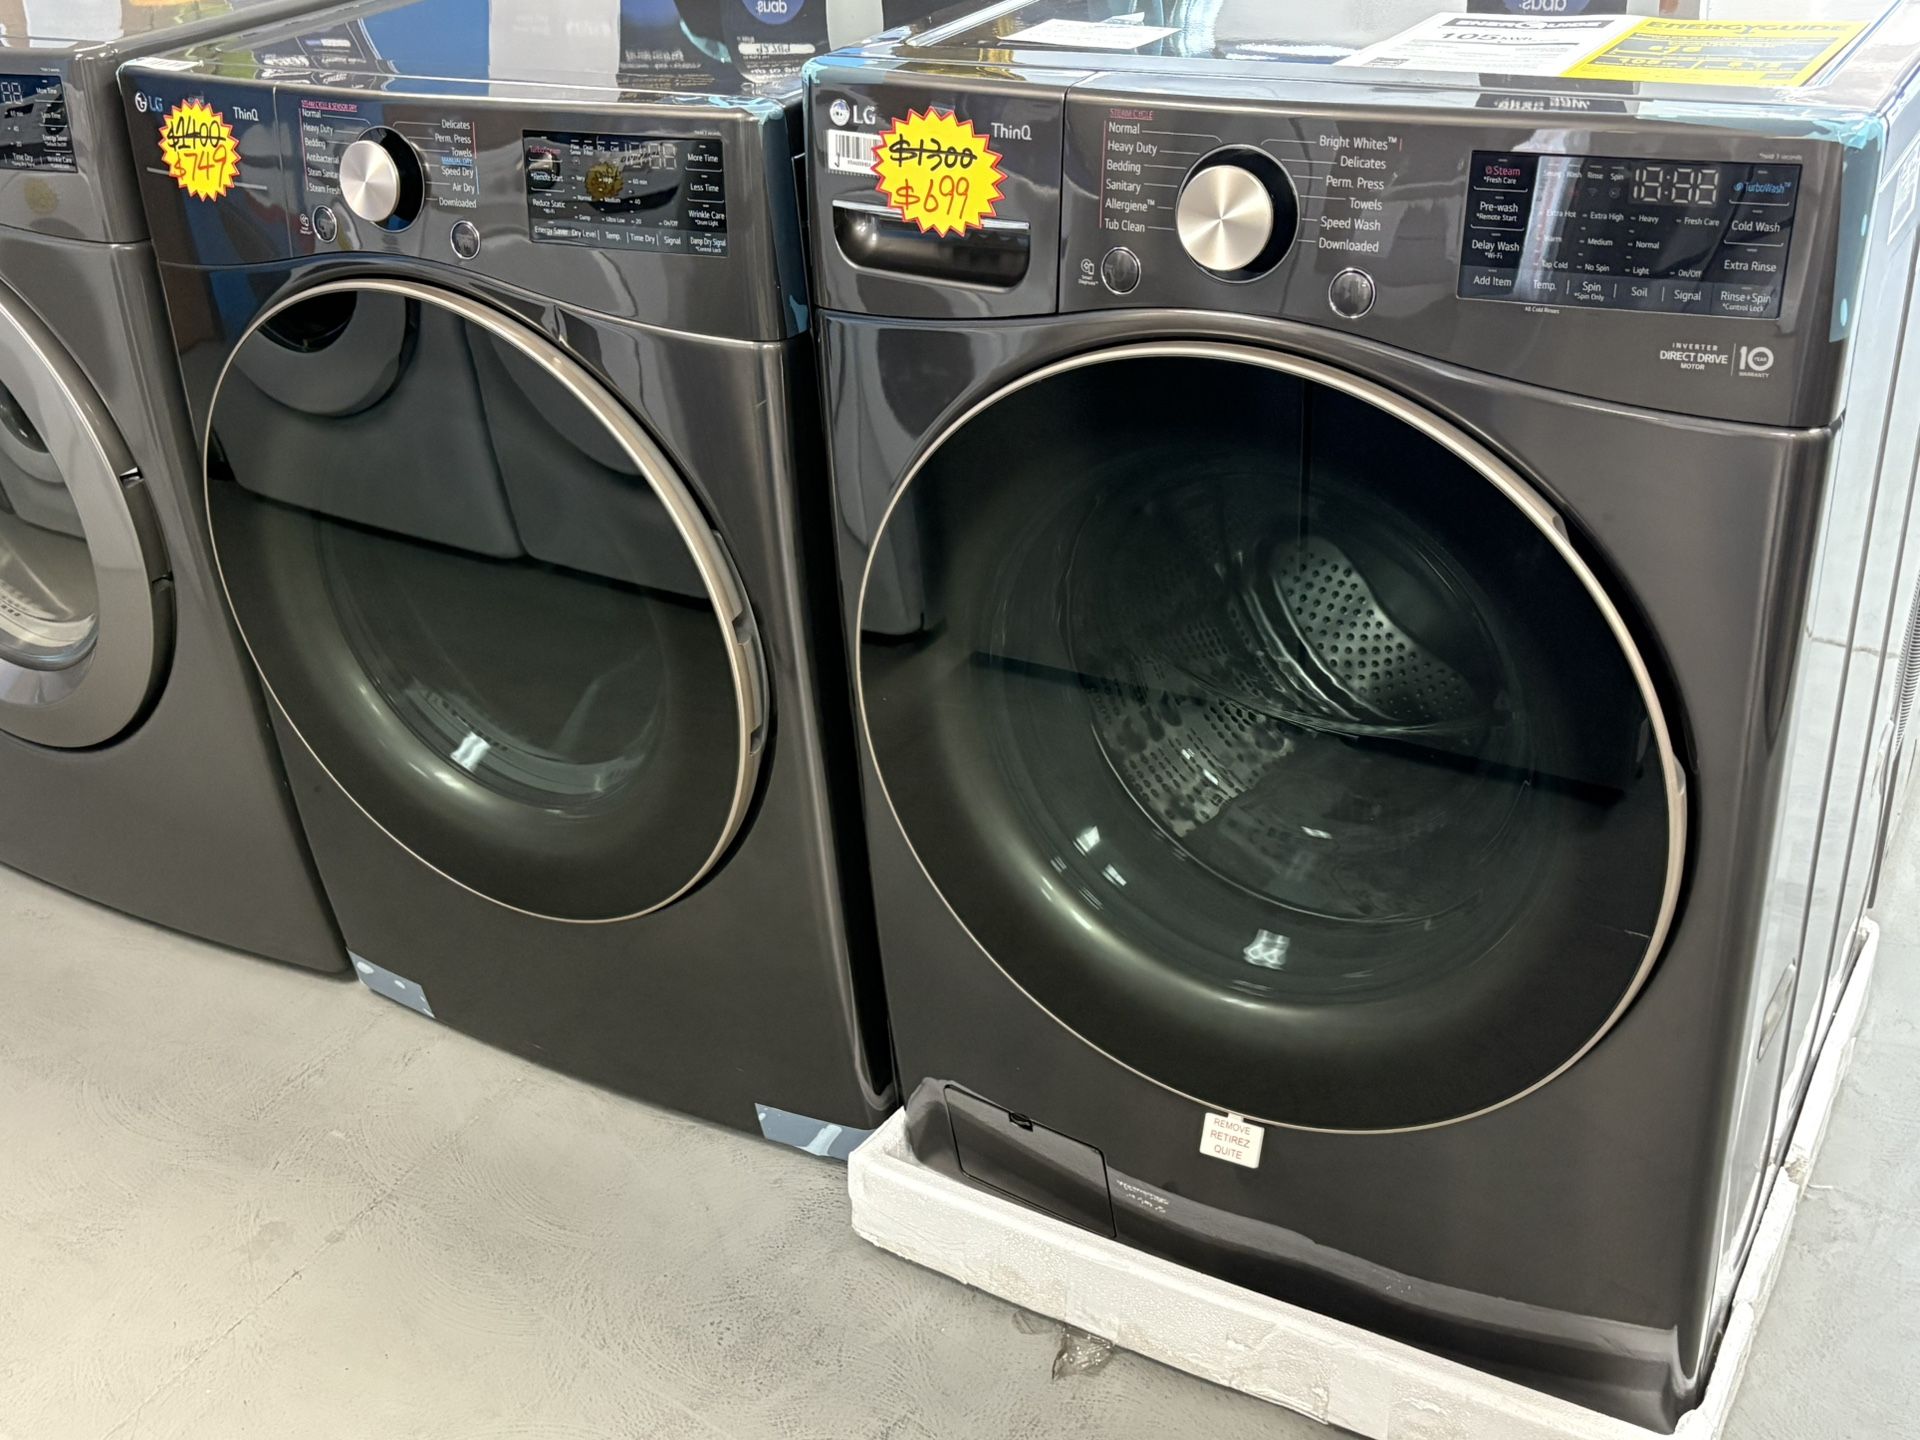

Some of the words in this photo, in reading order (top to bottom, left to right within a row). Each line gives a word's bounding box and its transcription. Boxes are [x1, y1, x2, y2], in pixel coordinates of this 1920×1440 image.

[148, 95, 163, 112] LG
[232, 106, 259, 121] ThinQ
[302, 109, 321, 118] Normal
[853, 105, 876, 125] LG
[303, 123, 320, 134] Heavy
[320, 124, 334, 135] Duty
[441, 119, 470, 130] Delicates
[1108, 122, 1140, 134] Normal
[167, 115, 226, 151] $1400
[991, 123, 1032, 141] ThinQ
[304, 138, 326, 150] Bedding
[435, 133, 452, 144] Perm.
[454, 134, 471, 144] Press
[1319, 135, 1350, 150] Bright
[451, 147, 472, 157] Towels
[889, 134, 978, 171] $1300
[1107, 140, 1134, 155] Heavy
[1136, 142, 1158, 157] Duty
[688, 153, 702, 162] More
[704, 154, 719, 163] Time
[1340, 155, 1386, 170] Delicates
[174, 144, 227, 187] $749
[1106, 159, 1141, 175] Bedding
[1492, 165, 1521, 176] Steam
[441, 167, 460, 177] Speed
[461, 168, 474, 178] Dry
[1587, 172, 1604, 180] Rinse
[1610, 173, 1624, 181] Spin
[308, 183, 326, 193] Steam
[452, 183, 462, 191] Air
[463, 183, 475, 194] Dry
[690, 183, 704, 191] Less
[705, 184, 719, 192] Time
[1106, 179, 1141, 195] Sanitary
[1325, 175, 1354, 188] Perm.
[1357, 176, 1385, 190] Press
[439, 197, 477, 208] Downloaded
[894, 175, 970, 219] $699
[1349, 197, 1383, 211] Towels
[1480, 201, 1519, 213] Pre-wash
[688, 210, 710, 219] Wrinkle
[711, 211, 725, 220] Care
[1502, 214, 1517, 222] Start
[1564, 209, 1577, 218] Hot
[1589, 211, 1608, 220] Extra
[1608, 213, 1625, 223] High
[1104, 218, 1120, 230] Tub
[1121, 219, 1146, 233] Clean
[1320, 216, 1351, 230] Speed
[1353, 218, 1381, 231] Wash
[1638, 215, 1659, 225] Heavy
[1684, 216, 1702, 226] Fresh
[1703, 217, 1720, 227] Care
[534, 226, 552, 235] Energy
[1731, 220, 1753, 231] Cold
[1755, 221, 1781, 233] Wash
[630, 232, 645, 242] Time
[645, 234, 655, 244] Dry
[1587, 237, 1613, 246] Medium
[1318, 237, 1379, 253] Downloaded
[1471, 240, 1495, 252] Delay
[1497, 241, 1520, 252] Wash
[1635, 240, 1660, 250] Normal
[1553, 261, 1569, 269] Cold
[1584, 263, 1595, 271] No
[1595, 264, 1610, 273] Spin
[1723, 259, 1749, 271] Extra
[1750, 261, 1777, 273] Rinse
[1632, 266, 1650, 277] Light
[1473, 275, 1491, 286] Add
[1492, 276, 1512, 287] Item
[1533, 279, 1557, 293] Temp.
[1582, 281, 1602, 293] Spin
[1591, 293, 1605, 302] Only
[1631, 286, 1648, 297] Soil
[1673, 289, 1702, 303] Signal
[1749, 304, 1764, 312] Lock
[1672, 342, 1718, 351] INVERTER
[1660, 350, 1696, 362] DIRECT
[1696, 353, 1729, 365] DRIVE
[1739, 345, 1775, 372] 10
[1680, 362, 1706, 370] MOTOR
[1214, 1118, 1251, 1135] REMOVE
[1210, 1130, 1250, 1148] RETIREZ
[1214, 1145, 1243, 1159] QUITE
